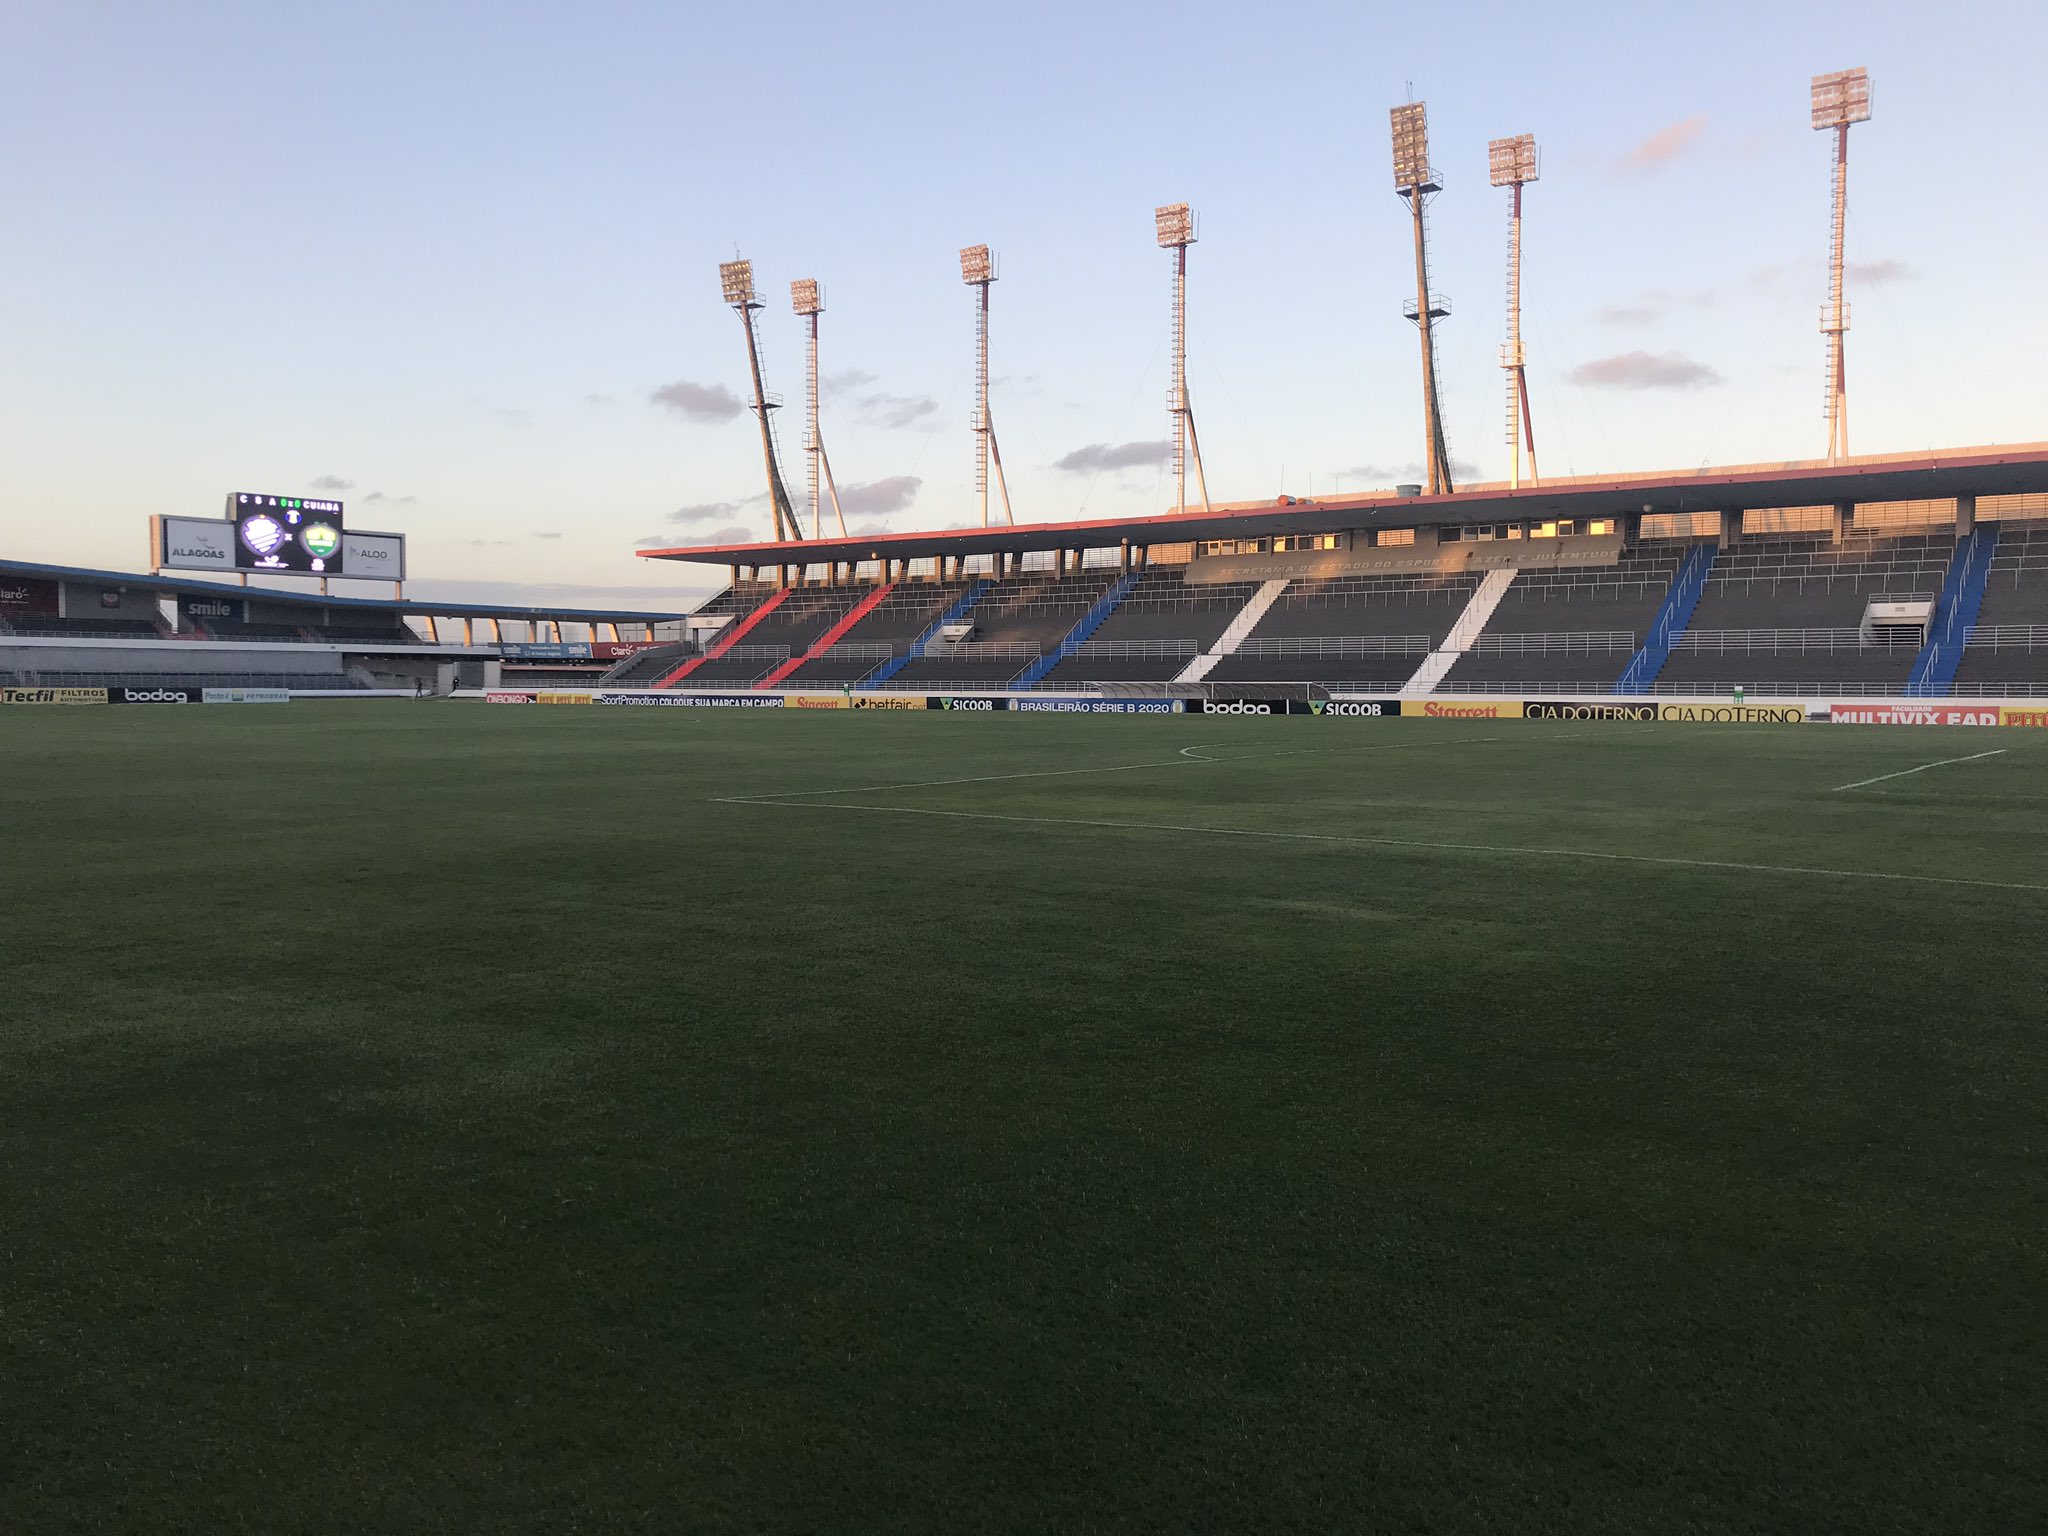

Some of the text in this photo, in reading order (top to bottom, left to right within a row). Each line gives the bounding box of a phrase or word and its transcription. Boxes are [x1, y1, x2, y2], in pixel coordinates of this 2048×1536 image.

[172, 548, 225, 559] ALAGOAS
[1320, 562, 1369, 571] ESTADO
[1532, 550, 1618, 561] JUVENTUDE
[188, 601, 231, 616] smile
[610, 643, 631, 656] Claro
[4, 690, 55, 702] Tecfil
[125, 688, 187, 704] bodog
[487, 695, 527, 704] ONBONGO
[695, 699, 711, 707] SUA
[712, 699, 740, 707] MARCA
[741, 699, 753, 707] EM
[754, 699, 784, 708] CAMPO
[953, 700, 993, 711] SICOOB
[1021, 700, 1170, 713] BRASILEIRÃO SÉRIE B 2020
[1326, 703, 1382, 716] SICOOB
[1831, 711, 1997, 726] MULTIVIX EAD
